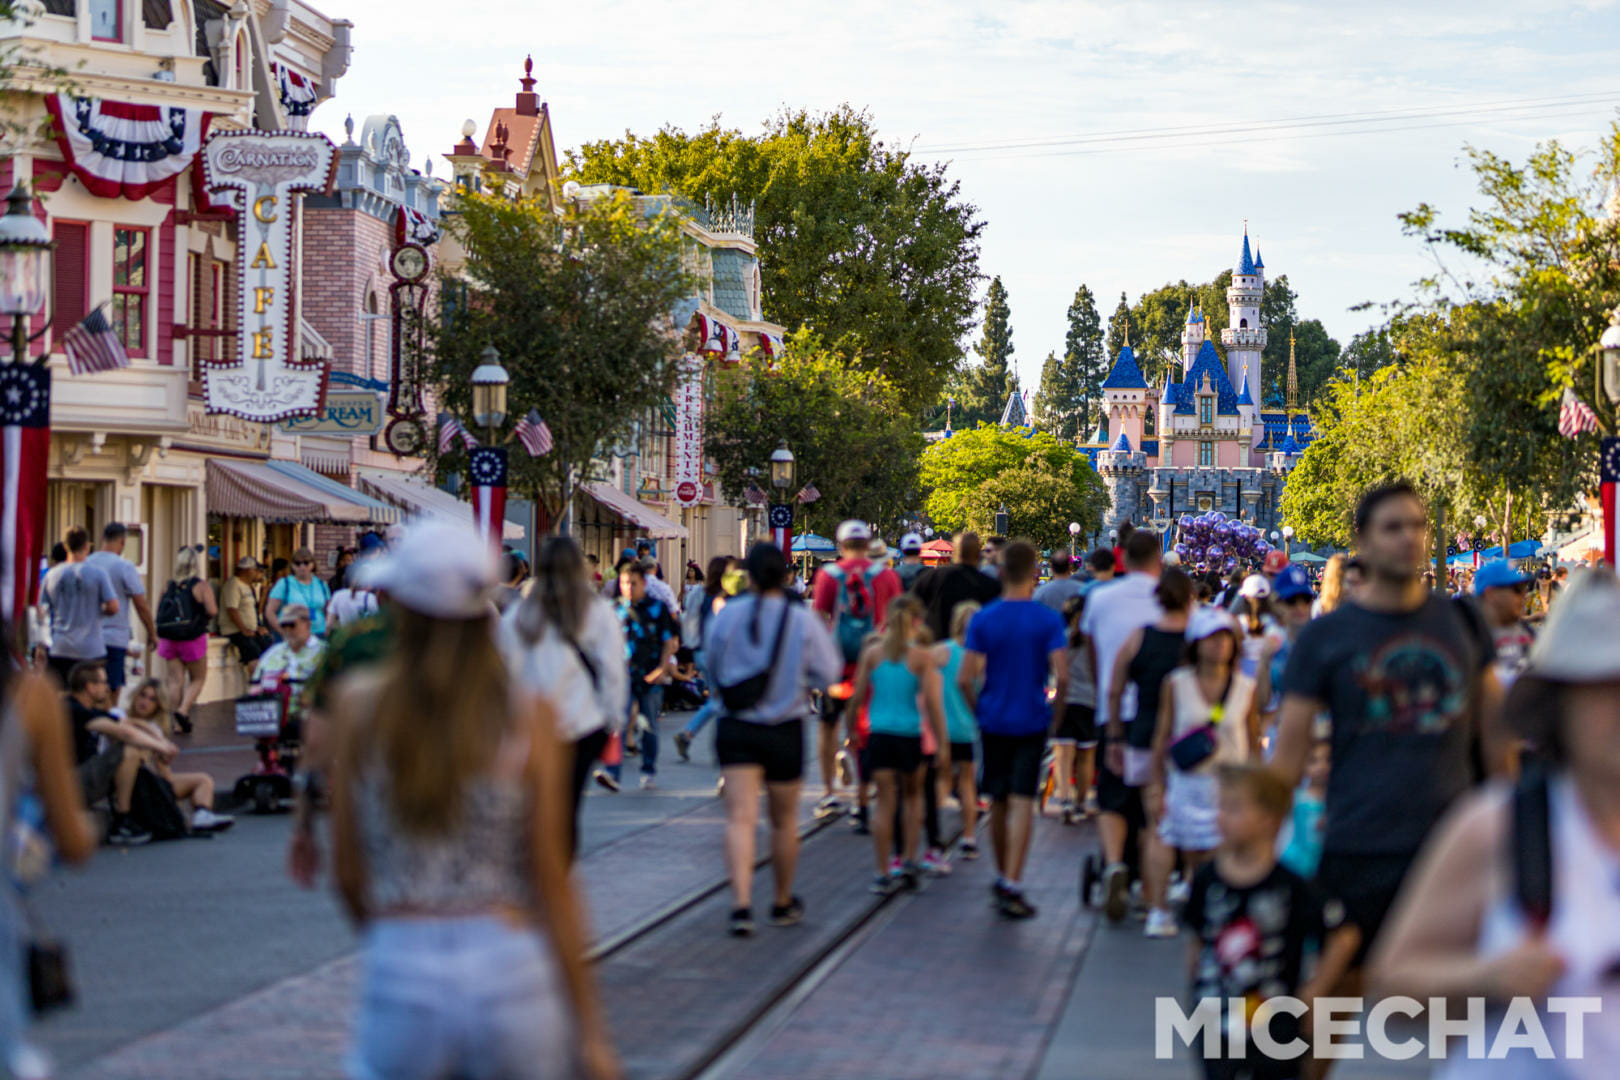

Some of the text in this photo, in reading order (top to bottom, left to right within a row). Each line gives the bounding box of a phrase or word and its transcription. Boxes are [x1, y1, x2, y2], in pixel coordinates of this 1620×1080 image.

[216, 147, 318, 173] CARNATION
[251, 195, 278, 359] CAFÉ
[682, 367, 693, 479] FRESHMENTS
